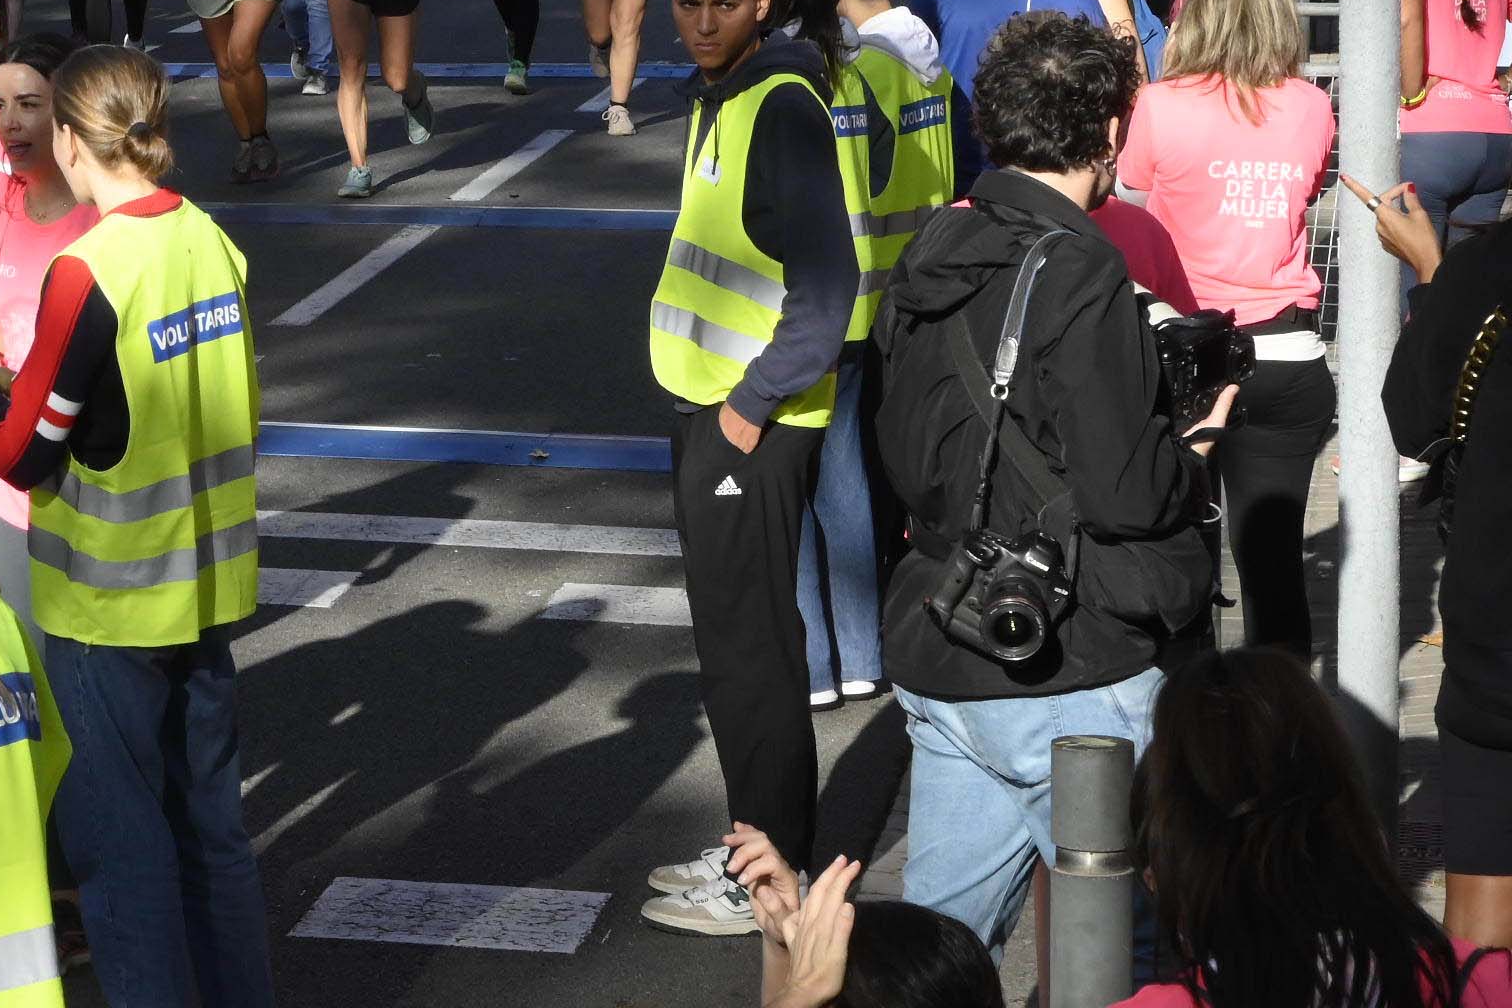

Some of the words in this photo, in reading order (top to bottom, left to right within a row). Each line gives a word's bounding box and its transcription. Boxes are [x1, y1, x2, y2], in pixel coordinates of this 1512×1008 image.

[1208, 160, 1305, 182] CARRERA
[1226, 179, 1255, 198] DE
[1261, 180, 1286, 199] LA
[1218, 198, 1288, 219] MUJER
[152, 303, 240, 350] VOLTARIS
